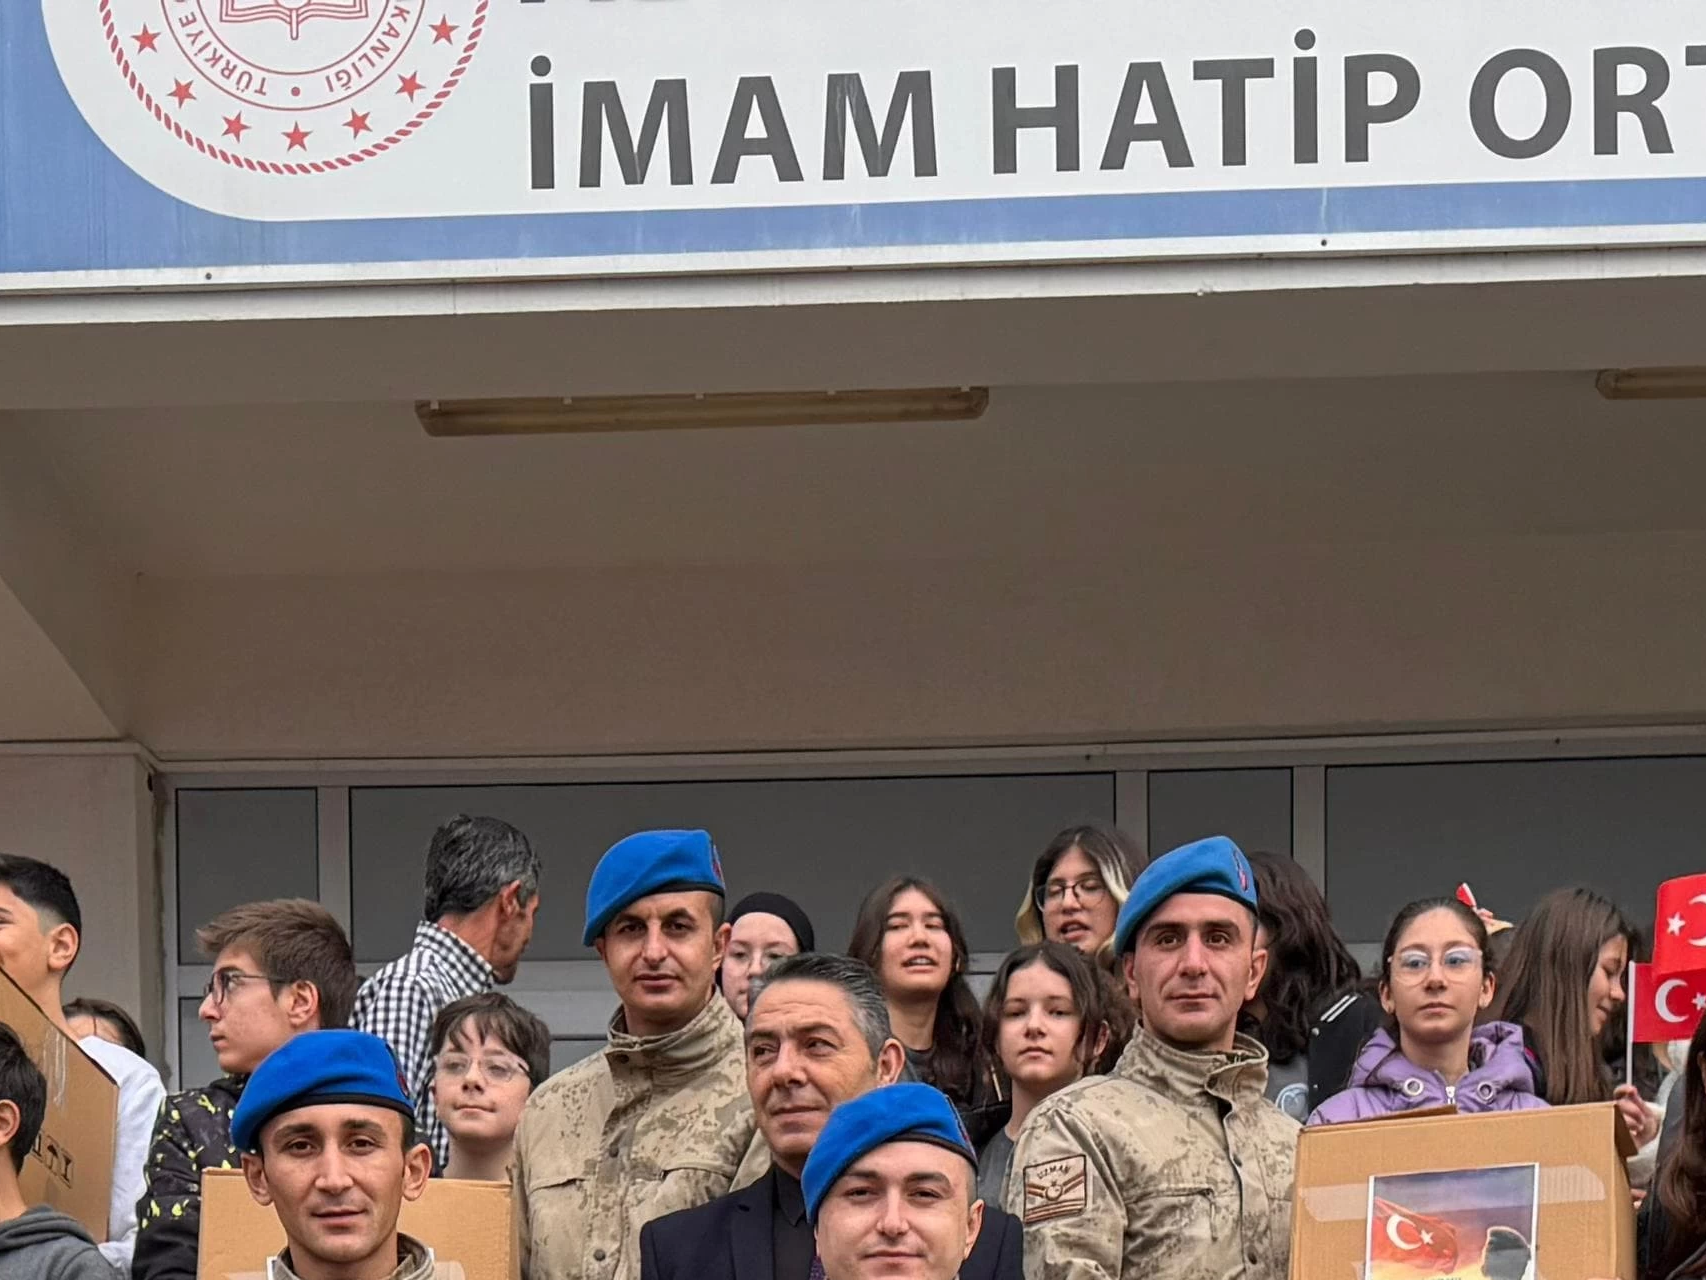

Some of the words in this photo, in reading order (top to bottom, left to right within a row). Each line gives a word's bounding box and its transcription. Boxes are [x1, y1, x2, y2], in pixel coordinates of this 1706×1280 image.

[179, 11, 267, 97] TÜRKİYE
[528, 55, 939, 191] İMAM
[991, 29, 1422, 176] HATİP
